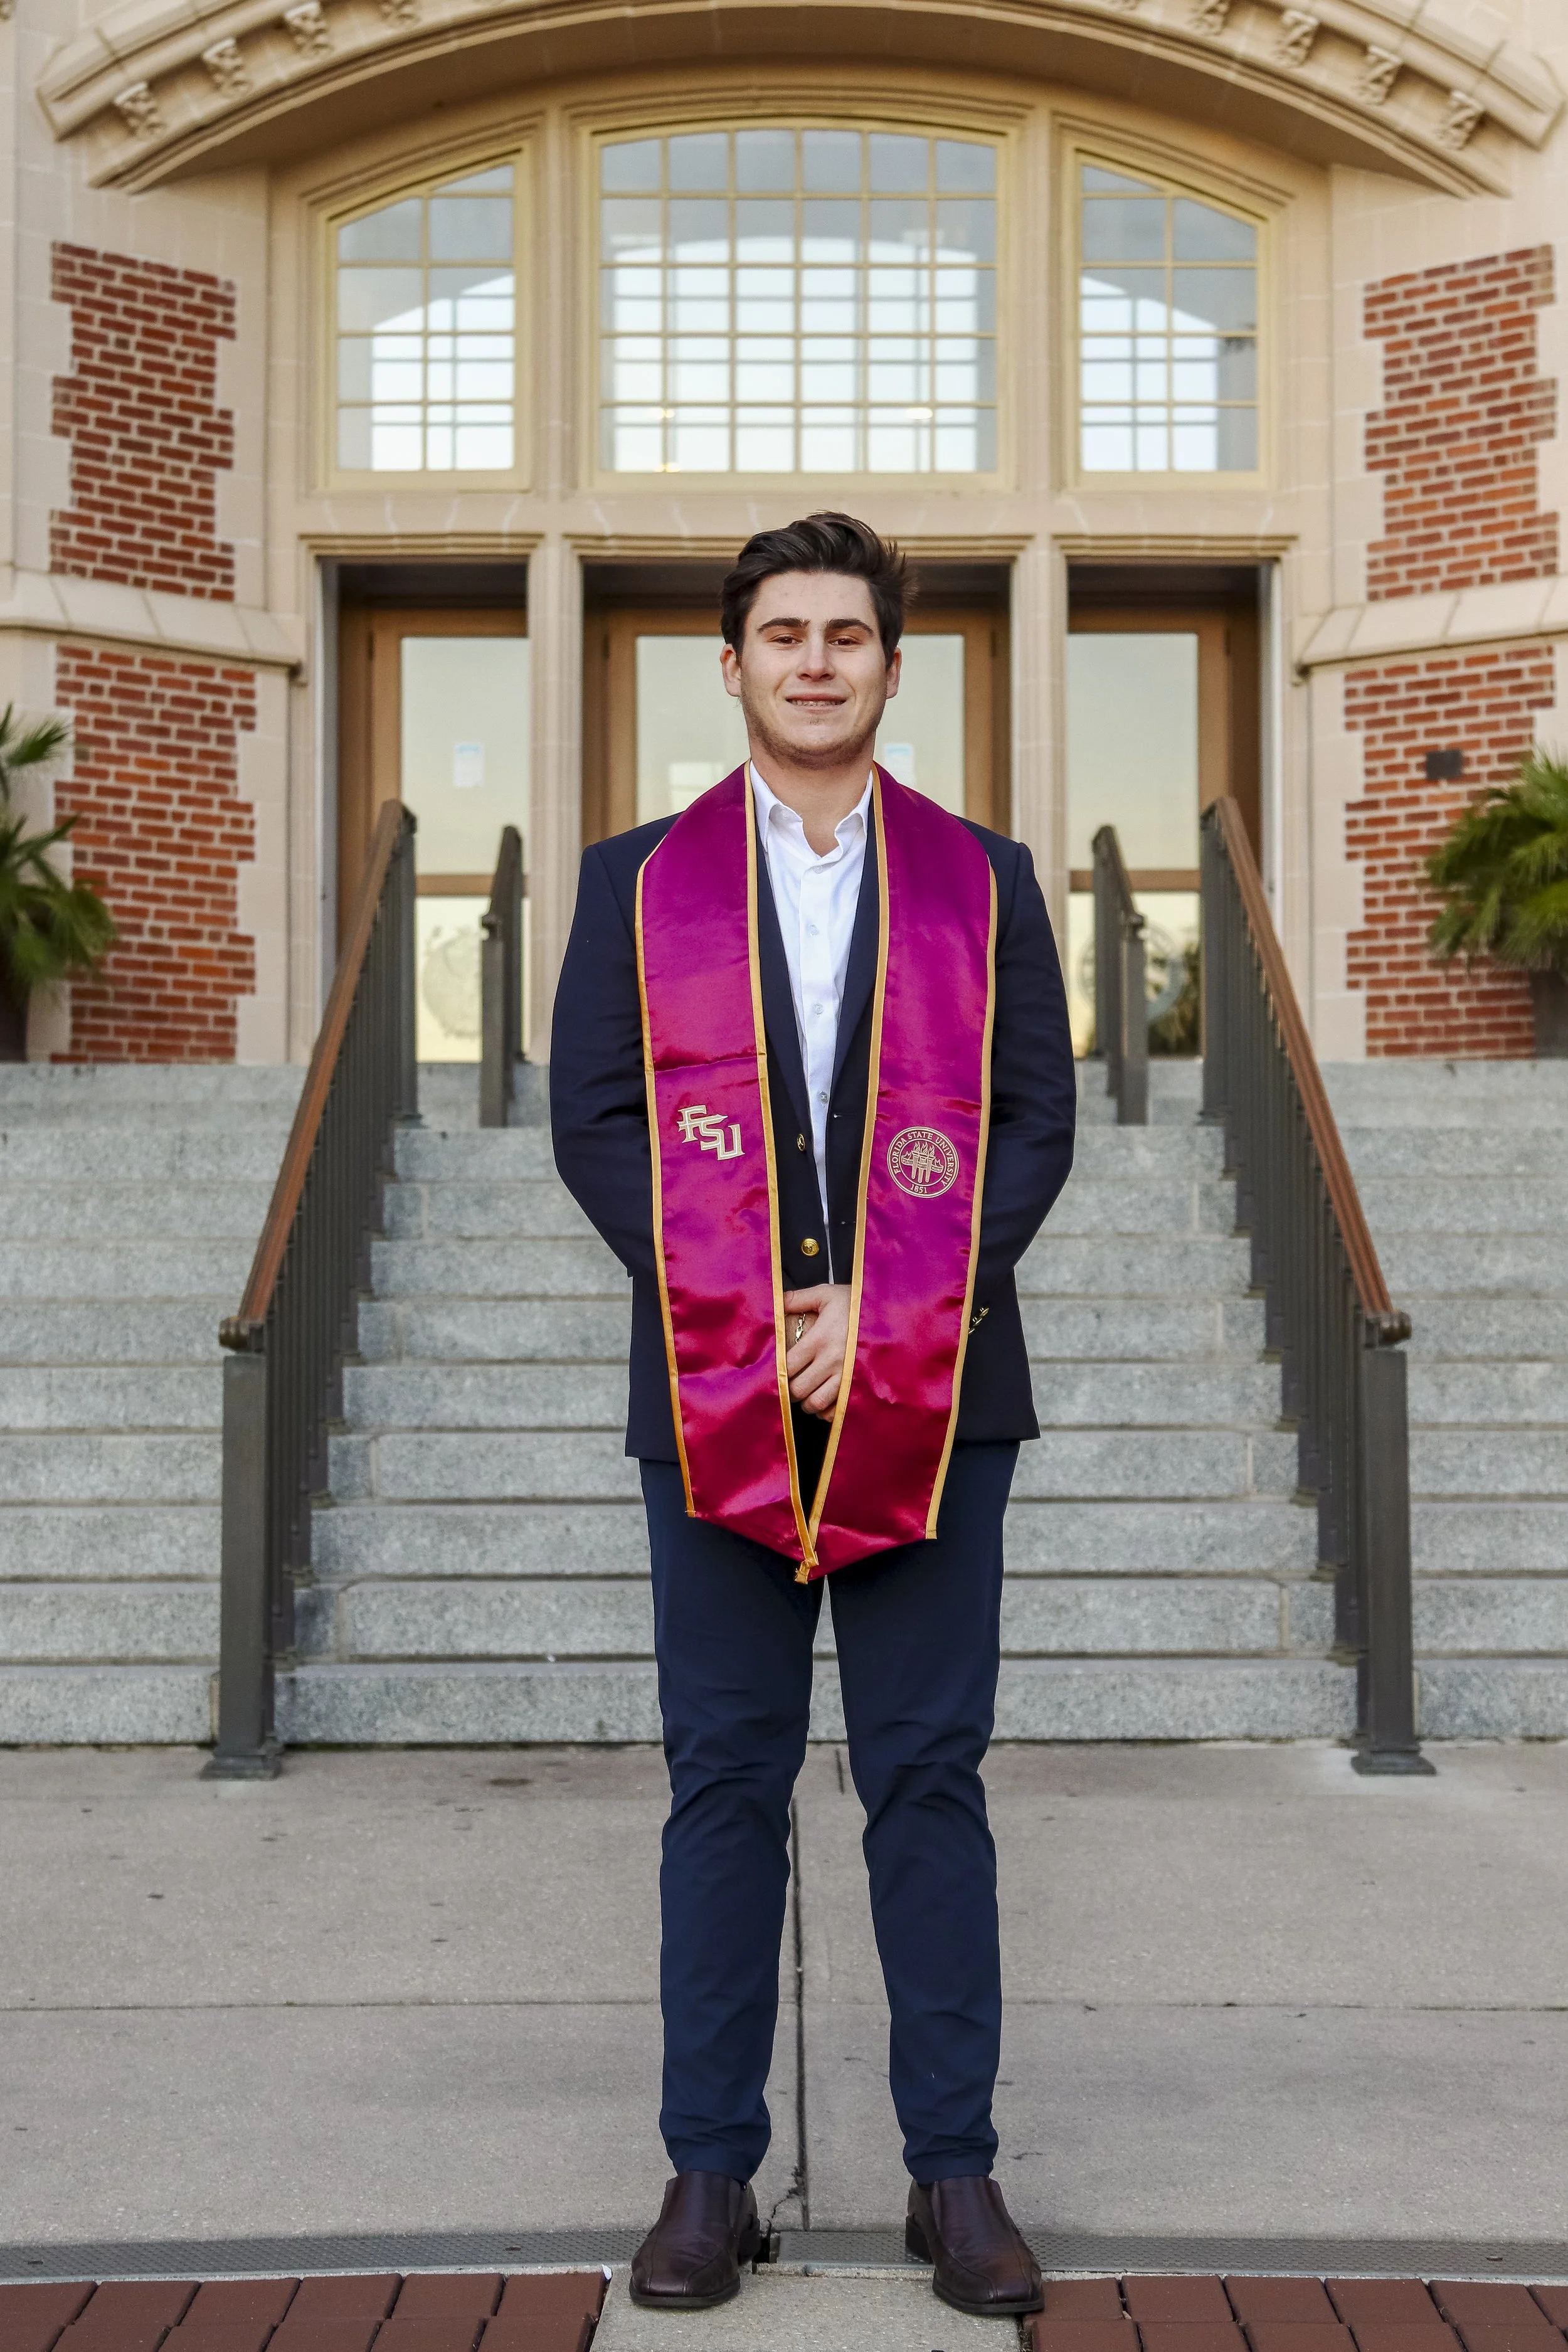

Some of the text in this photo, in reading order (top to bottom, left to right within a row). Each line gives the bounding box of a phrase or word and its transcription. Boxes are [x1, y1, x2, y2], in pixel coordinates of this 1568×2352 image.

[677, 1104, 745, 1160] FSU
[892, 1131, 954, 1187] FLORIDA STATE UNIVERSITY
[910, 1184, 928, 1194] 1851
